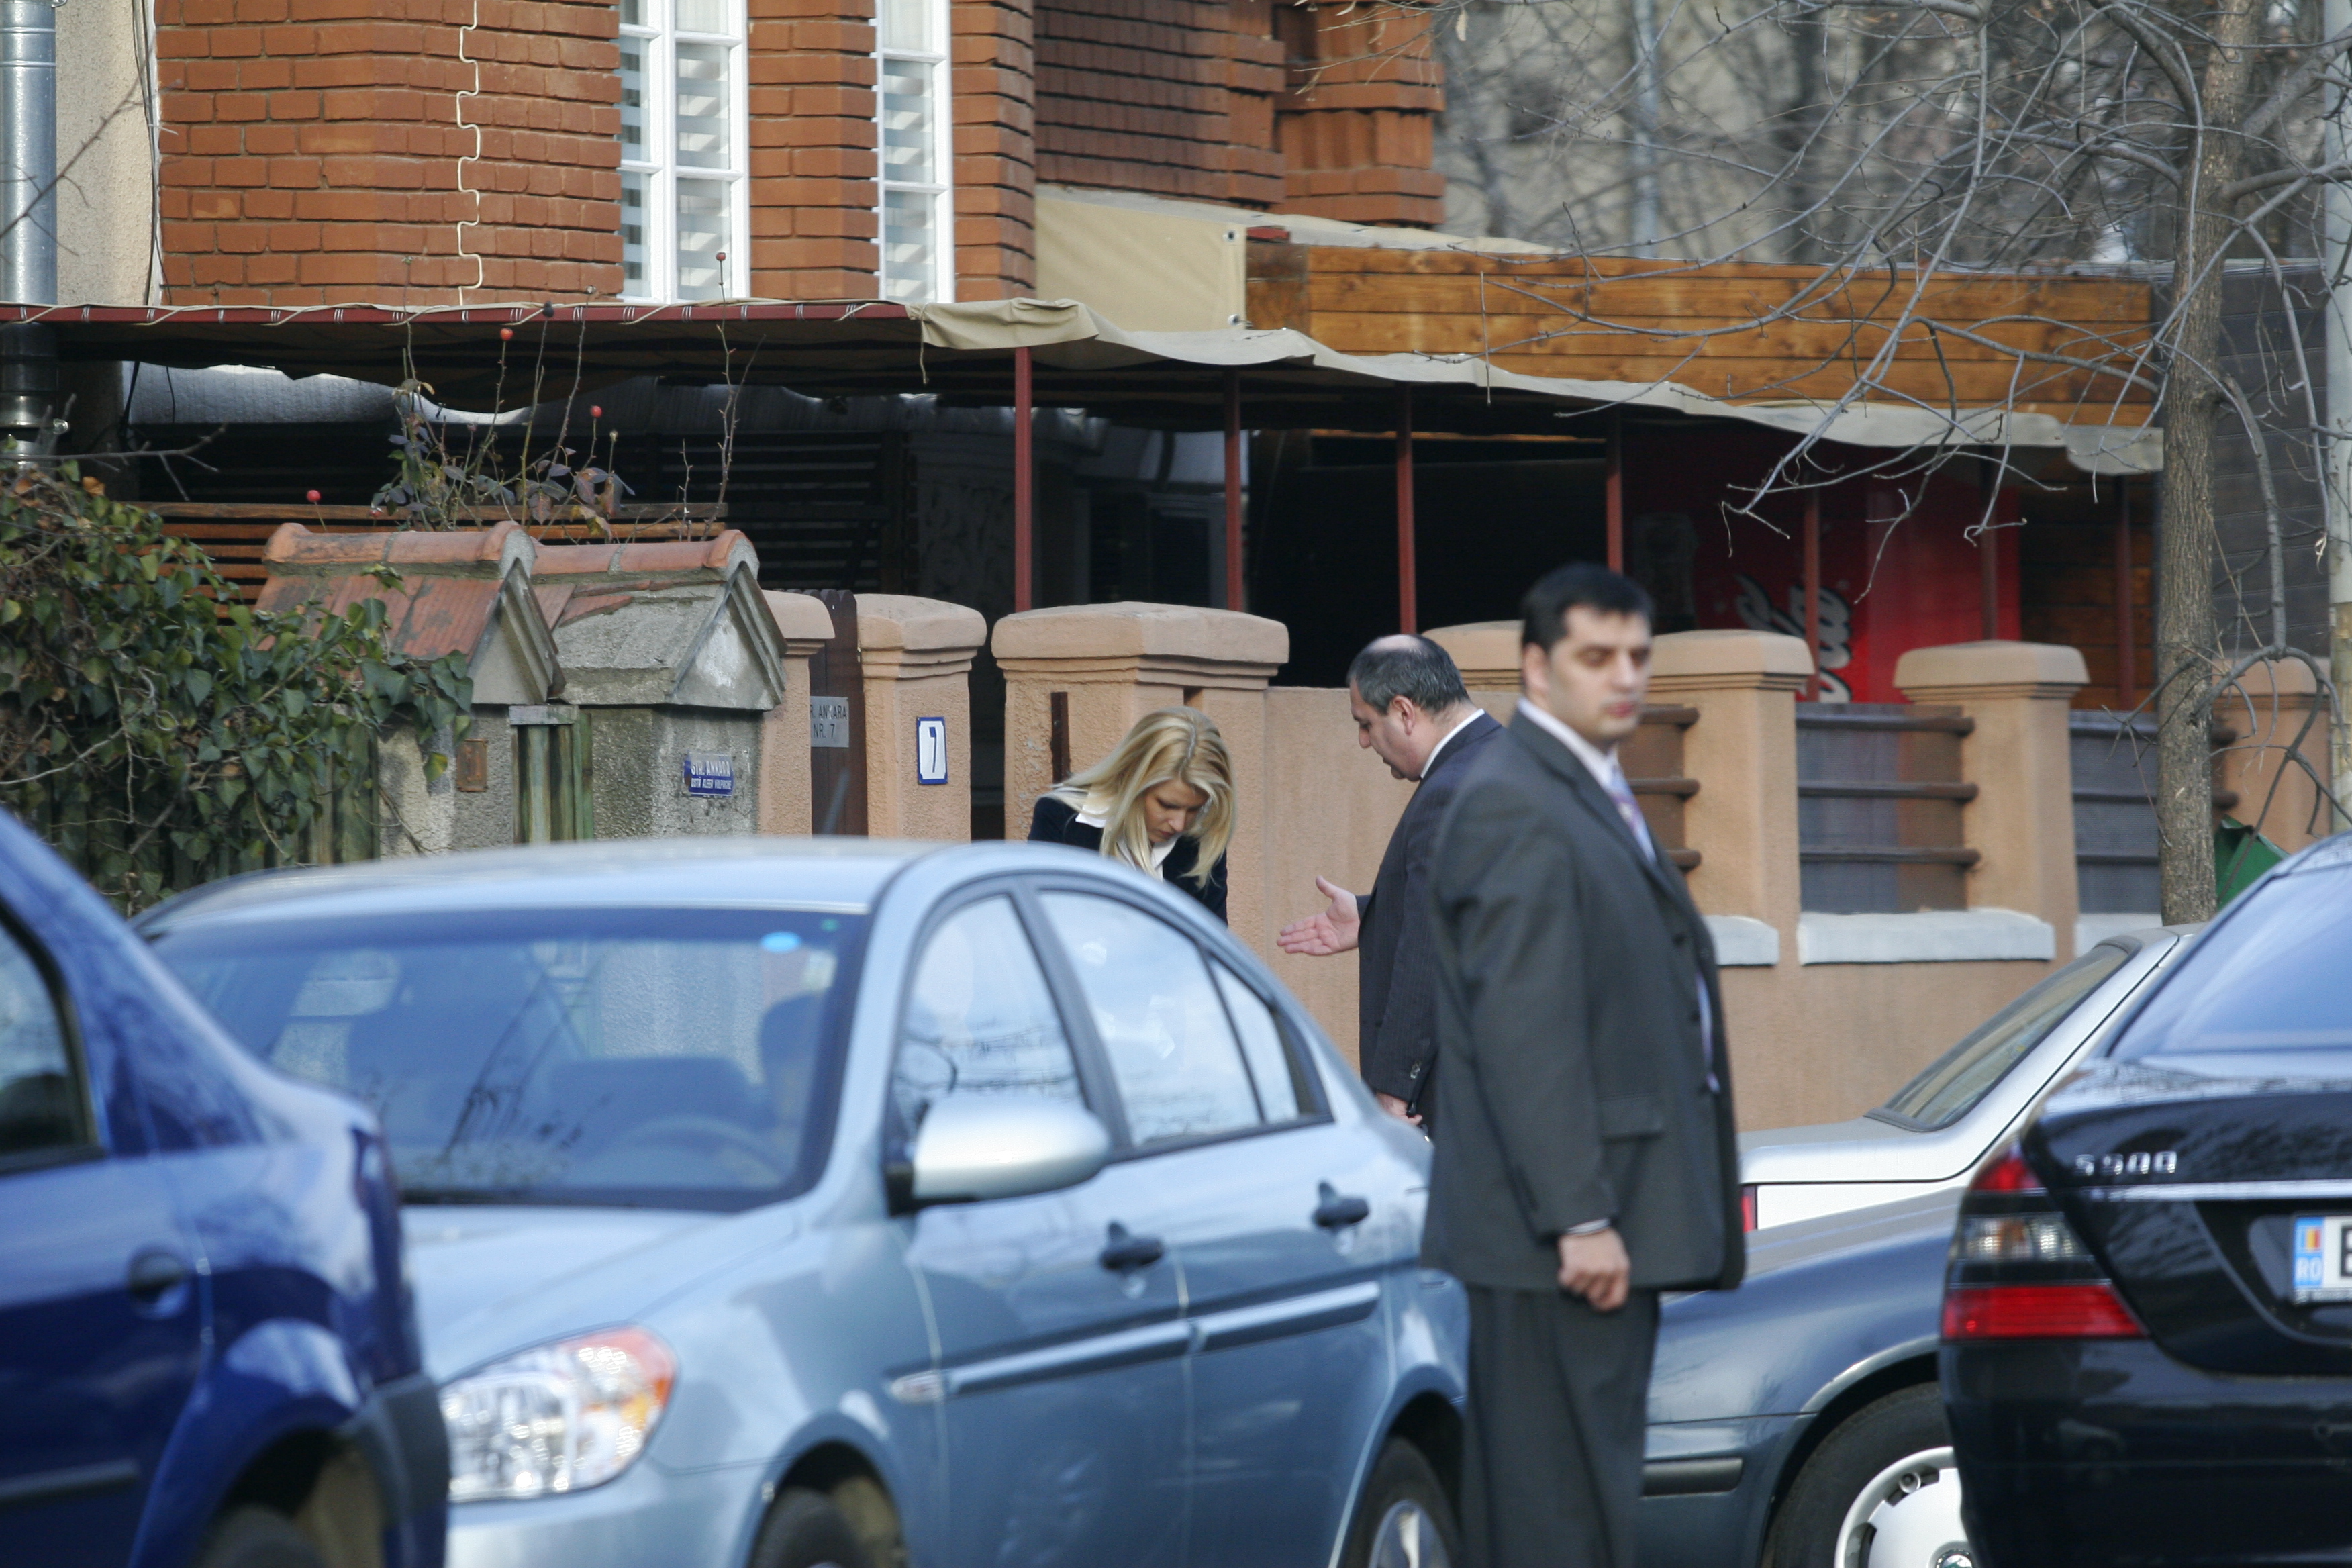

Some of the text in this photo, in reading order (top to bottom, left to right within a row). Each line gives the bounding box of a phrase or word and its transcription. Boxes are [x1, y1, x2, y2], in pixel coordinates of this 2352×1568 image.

[818, 704, 848, 720] ANKARA
[813, 723, 836, 739] NR. 7
[691, 760, 731, 777] STR. ANKARA
[2295, 1256, 2322, 1281] RO
